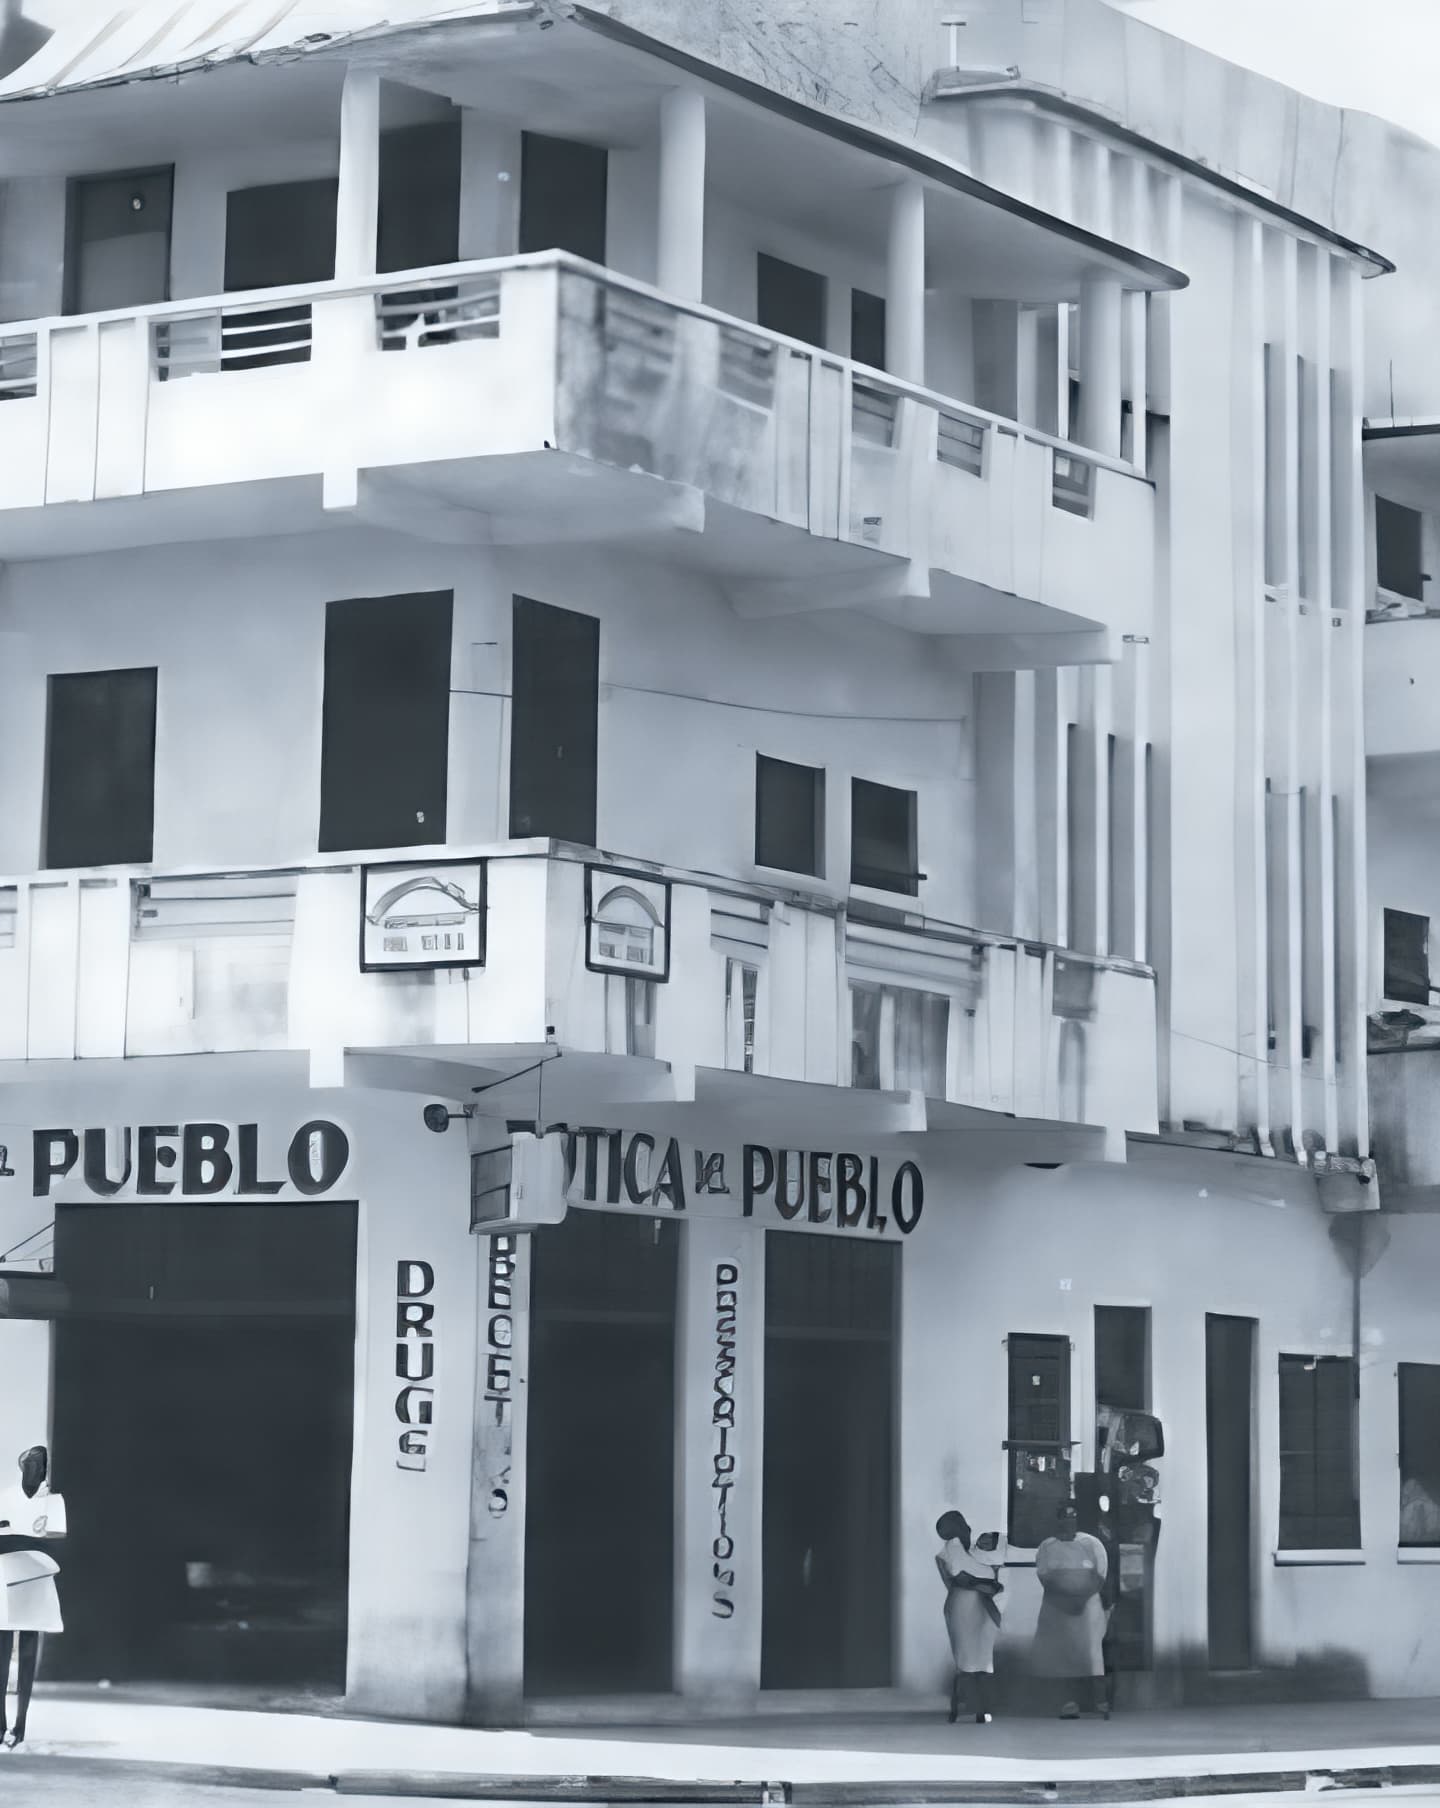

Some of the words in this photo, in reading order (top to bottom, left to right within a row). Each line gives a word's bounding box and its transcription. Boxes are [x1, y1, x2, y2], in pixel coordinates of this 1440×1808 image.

[32, 1120, 349, 1196] PUEBLO
[506, 1120, 687, 1211] TICA
[742, 1144, 924, 1235] PUEBLO
